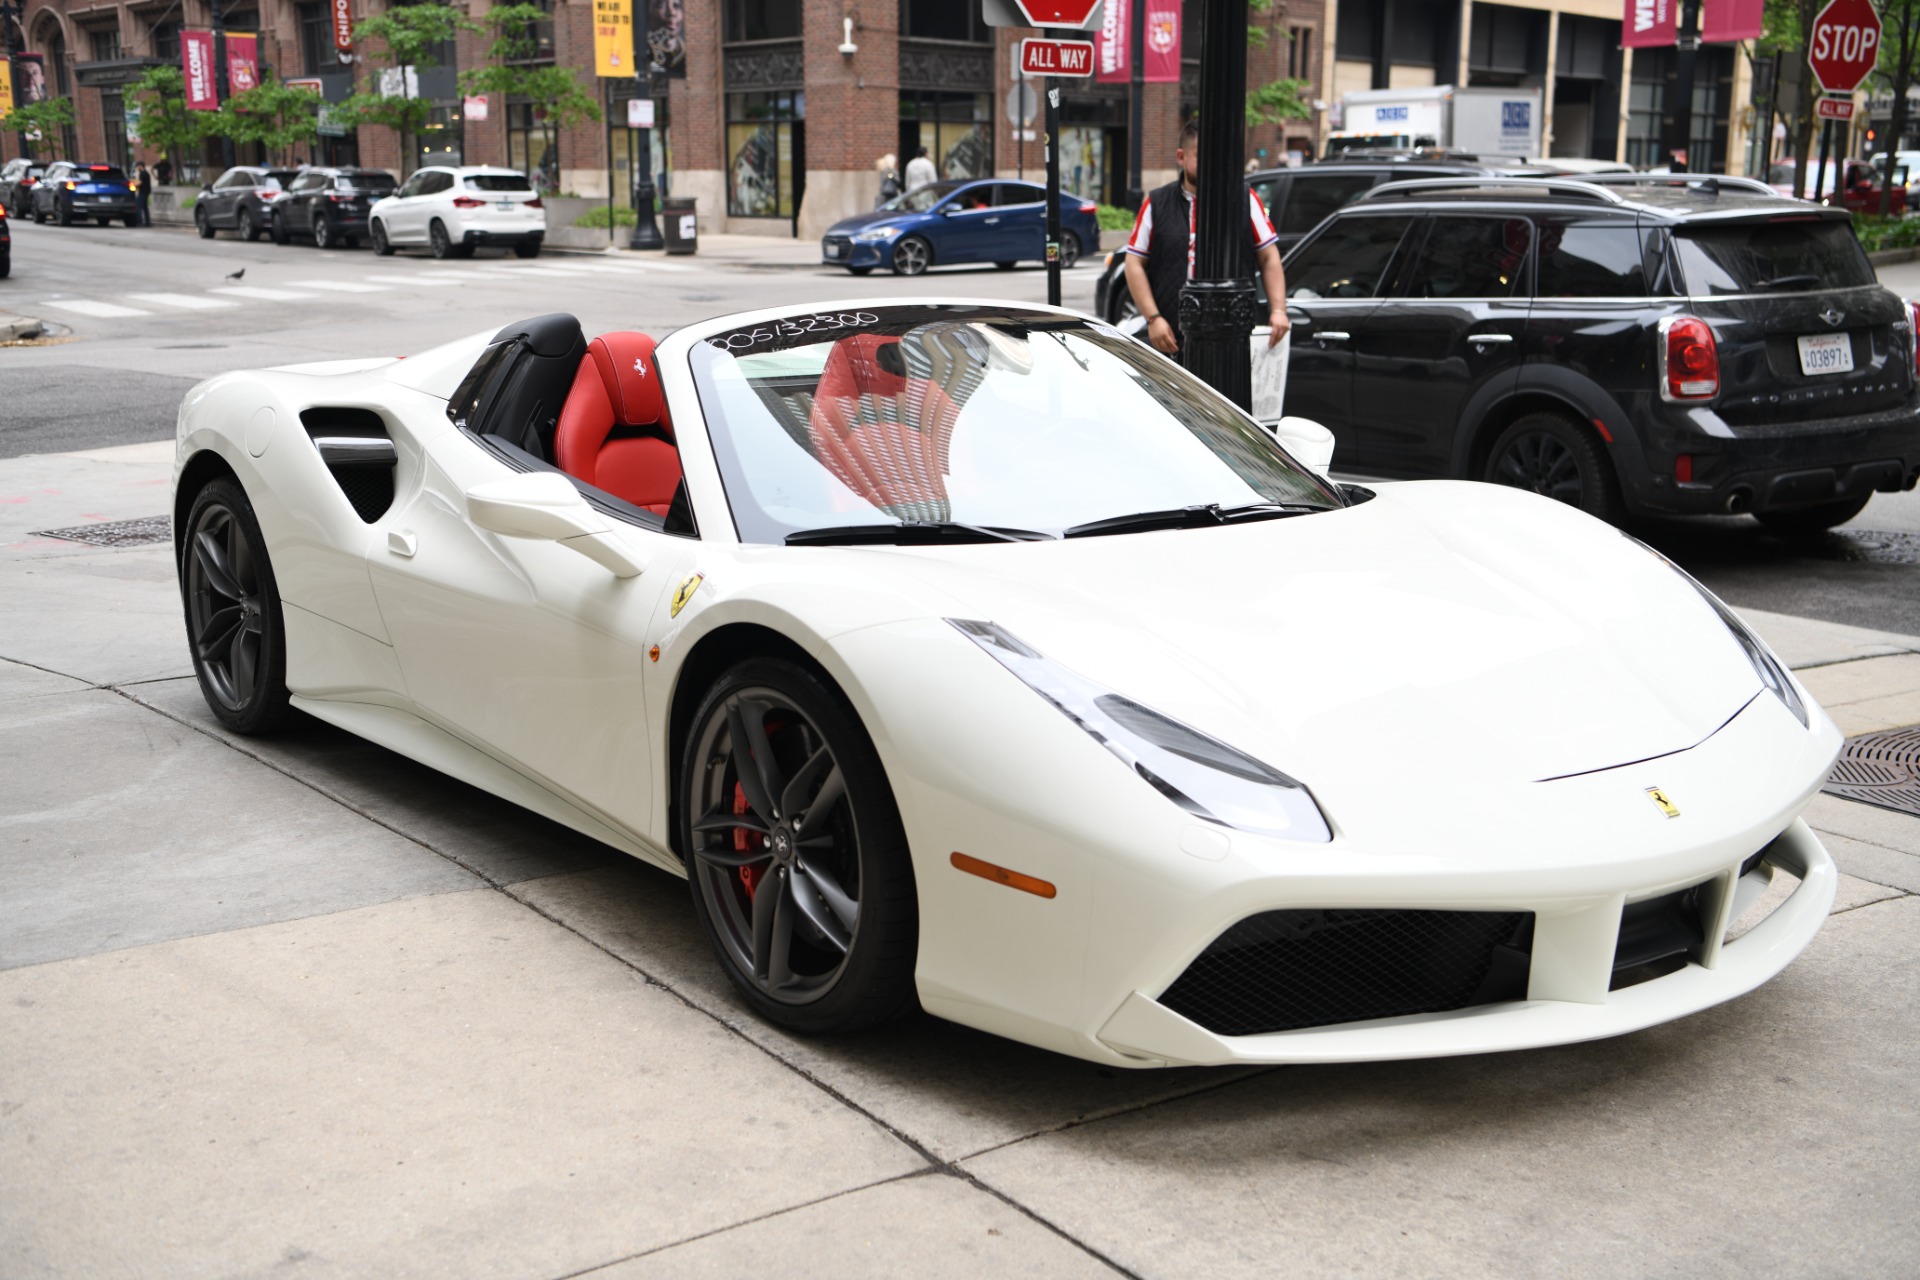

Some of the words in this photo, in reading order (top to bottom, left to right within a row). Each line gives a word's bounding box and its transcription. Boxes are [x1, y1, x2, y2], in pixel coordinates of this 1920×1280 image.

[1814, 24, 1876, 62] STOP
[1028, 47, 1055, 68] ALL
[1060, 48, 1087, 69] WAY
[187, 39, 205, 102] WELCOME
[1821, 100, 1834, 114] ALL
[1837, 101, 1851, 116] WAY
[1810, 347, 1842, 368] 03897
[1751, 382, 1899, 405] COUNTRYMAN
